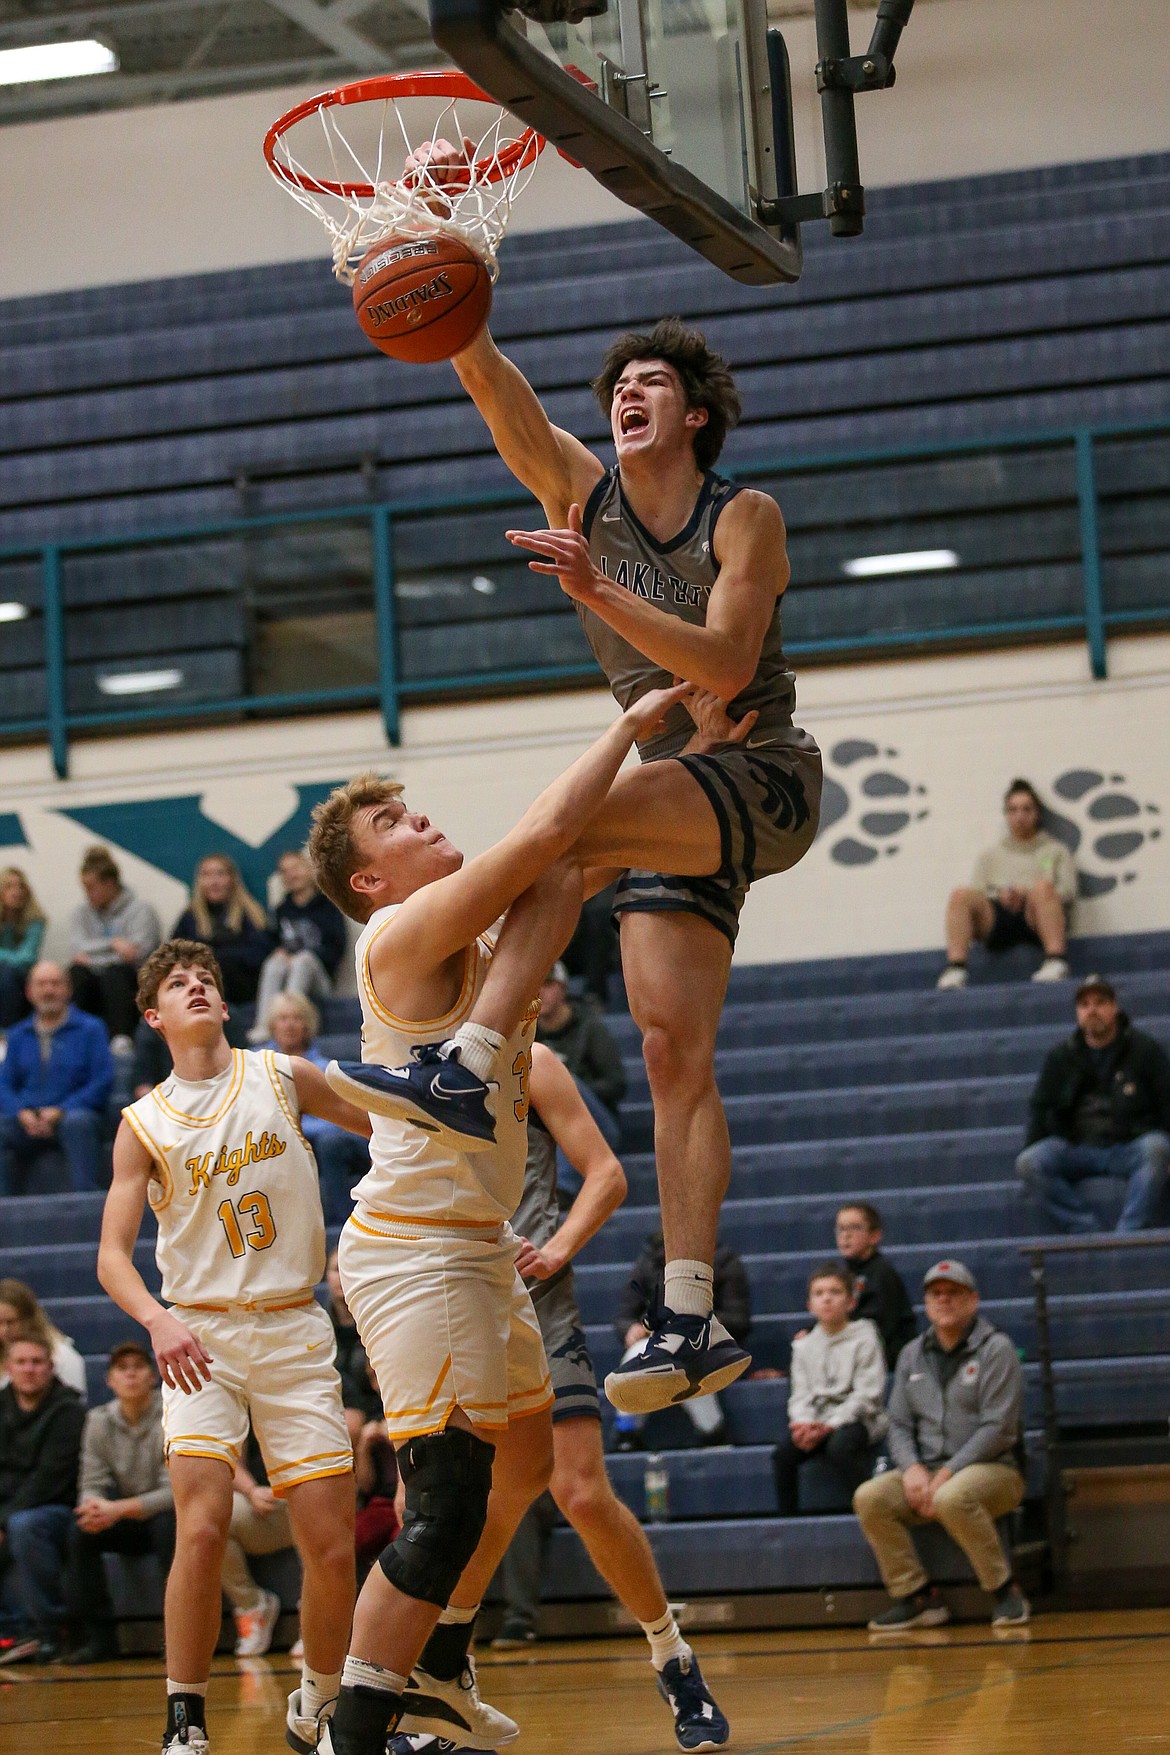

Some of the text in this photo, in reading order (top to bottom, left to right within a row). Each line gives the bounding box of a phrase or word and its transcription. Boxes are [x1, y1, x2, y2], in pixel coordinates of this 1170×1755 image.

[360, 240, 438, 288] PRECISION
[366, 271, 453, 328] SPALDING
[600, 555, 665, 601] LAKE
[511, 1044, 533, 1123] 3
[185, 1130, 287, 1196] Kights
[217, 1190, 277, 1259] 13
